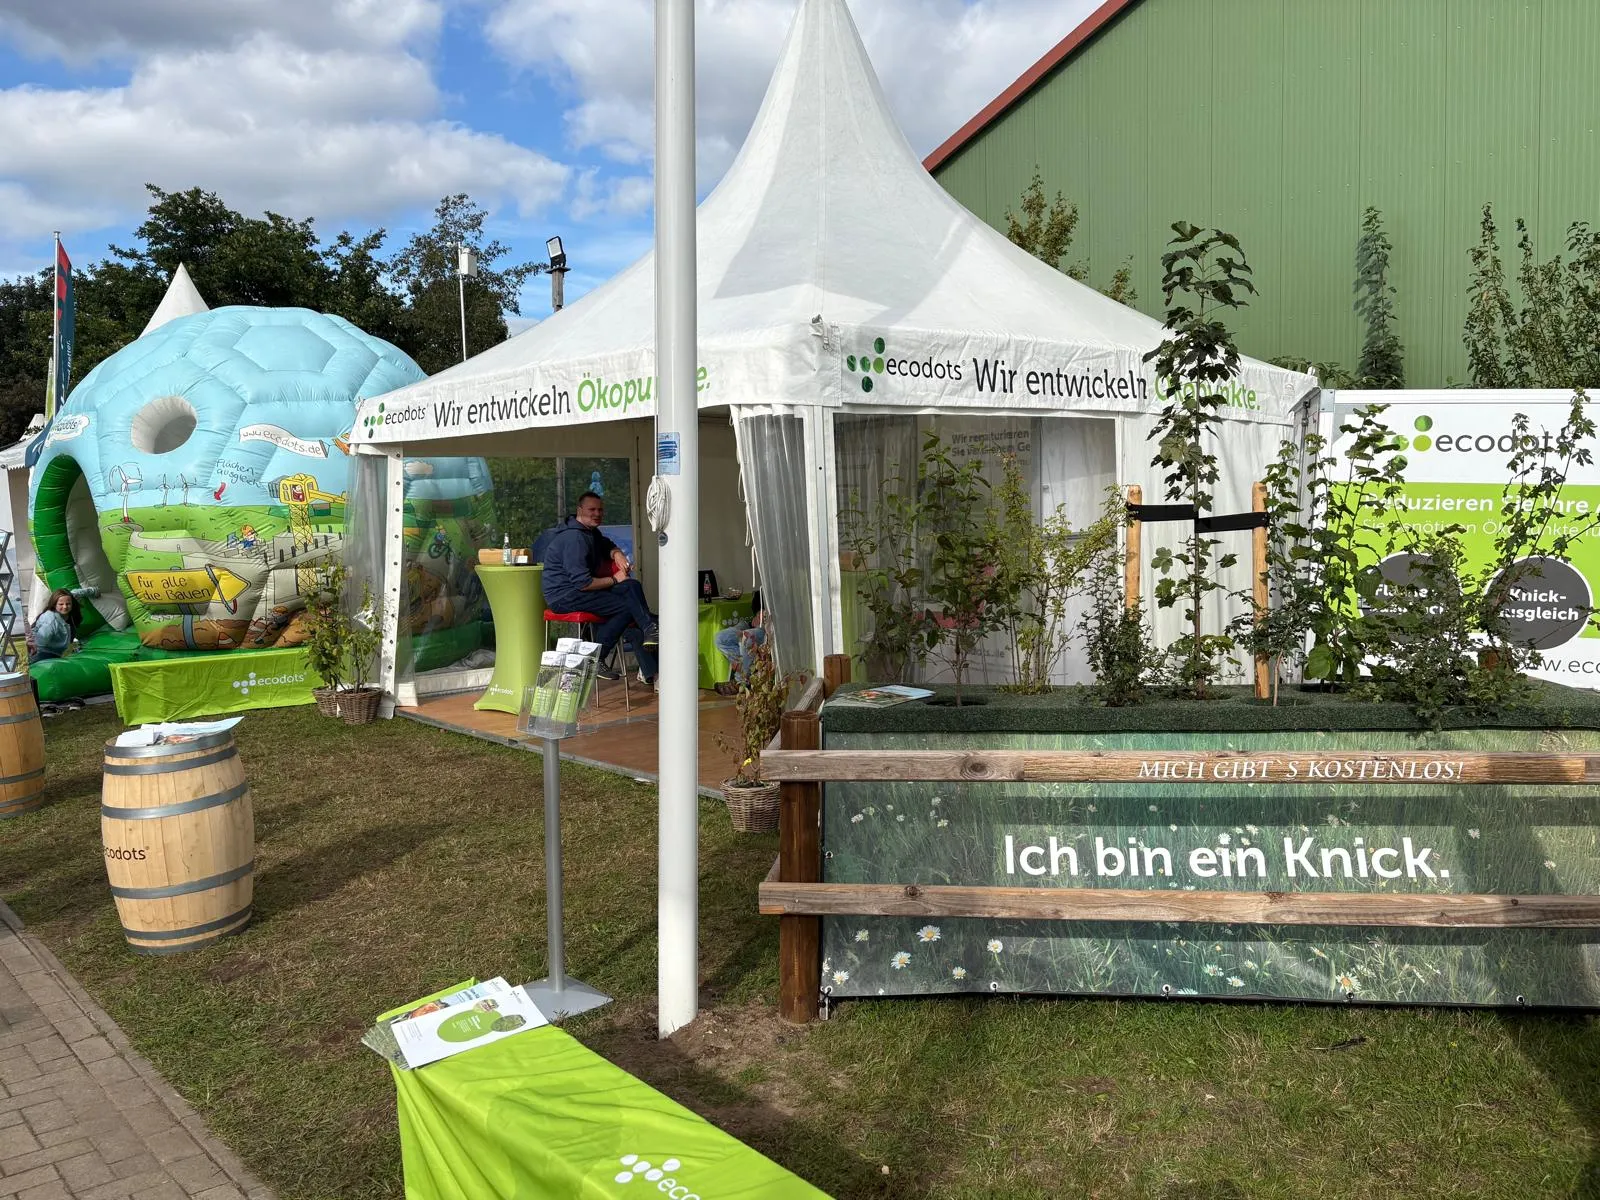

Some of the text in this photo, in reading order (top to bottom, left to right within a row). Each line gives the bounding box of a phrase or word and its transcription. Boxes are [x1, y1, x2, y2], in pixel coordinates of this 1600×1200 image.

[886, 356, 962, 381] ecodots
[972, 358, 1018, 394] Wir
[1026, 367, 1148, 400] entwickeln
[385, 366, 711, 428] ecodots Wir entwickeln Ökopue.
[1390, 520, 1476, 537] enötien
[1483, 518, 1579, 536] Ökounkte
[161, 576, 187, 589] alle
[143, 588, 211, 601] die Bauen
[1510, 588, 1567, 603] Knick-
[1542, 659, 1600, 675] w.ec
[257, 674, 304, 686] ecodots
[1137, 760, 1205, 779] MICH
[1306, 760, 1464, 780] KOSTENLOS!
[104, 846, 146, 861] codots
[1004, 832, 1450, 879] Ich bin ein Knick.
